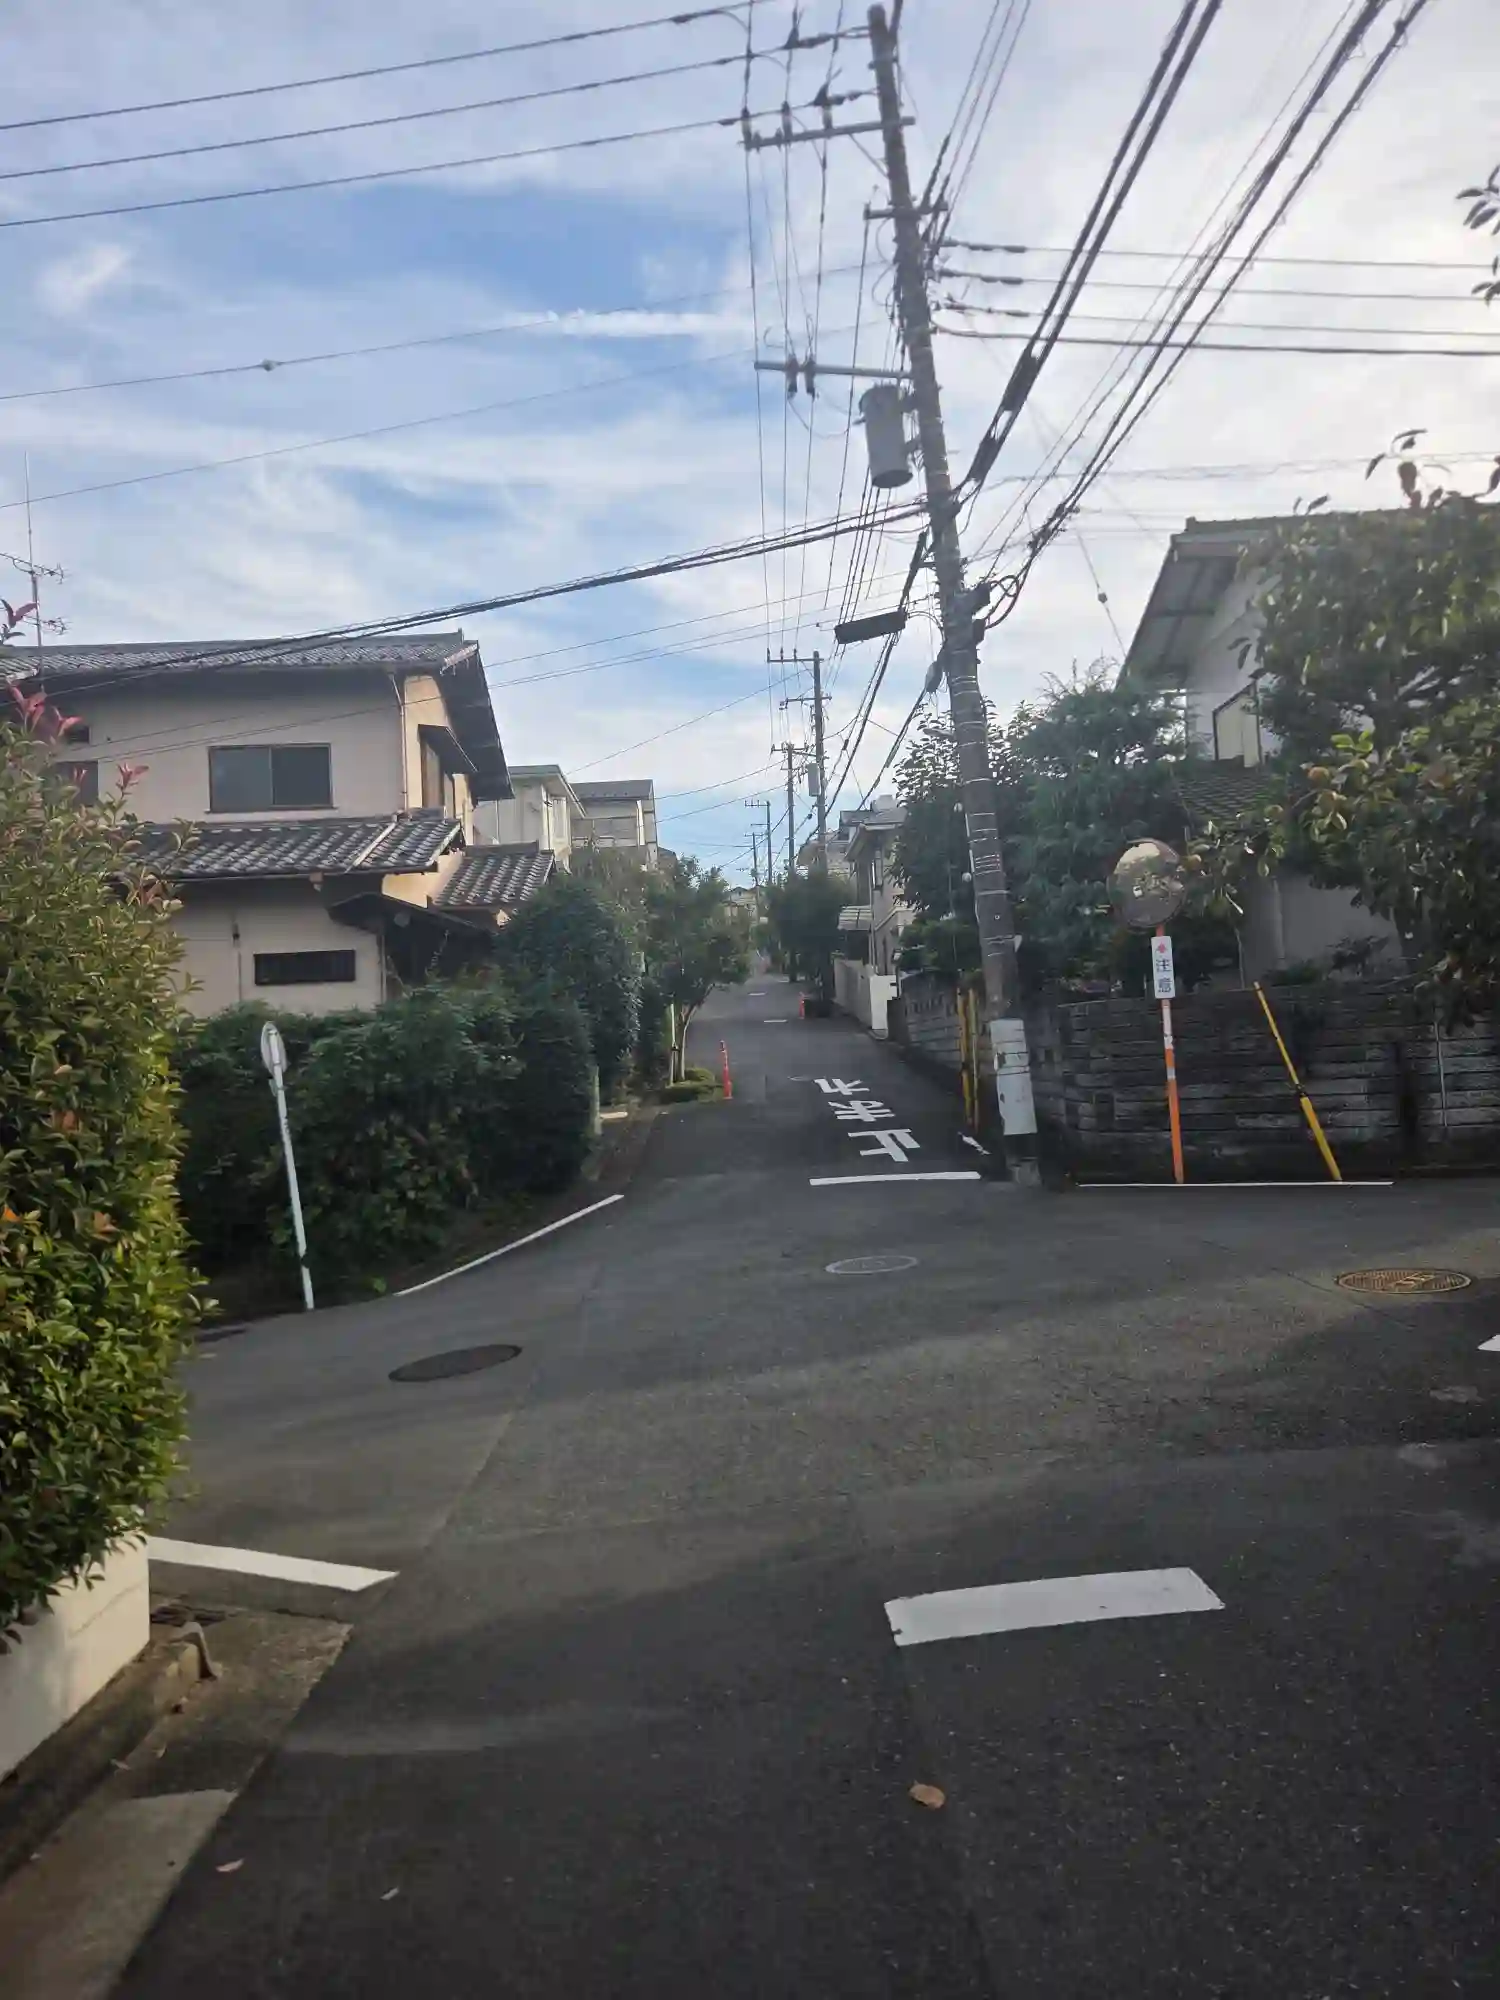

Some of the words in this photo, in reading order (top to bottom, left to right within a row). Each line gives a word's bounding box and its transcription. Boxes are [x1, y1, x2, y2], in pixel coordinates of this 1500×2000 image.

[1155, 957, 1173, 994] 注意
[814, 1078, 921, 1162] 止まれ
